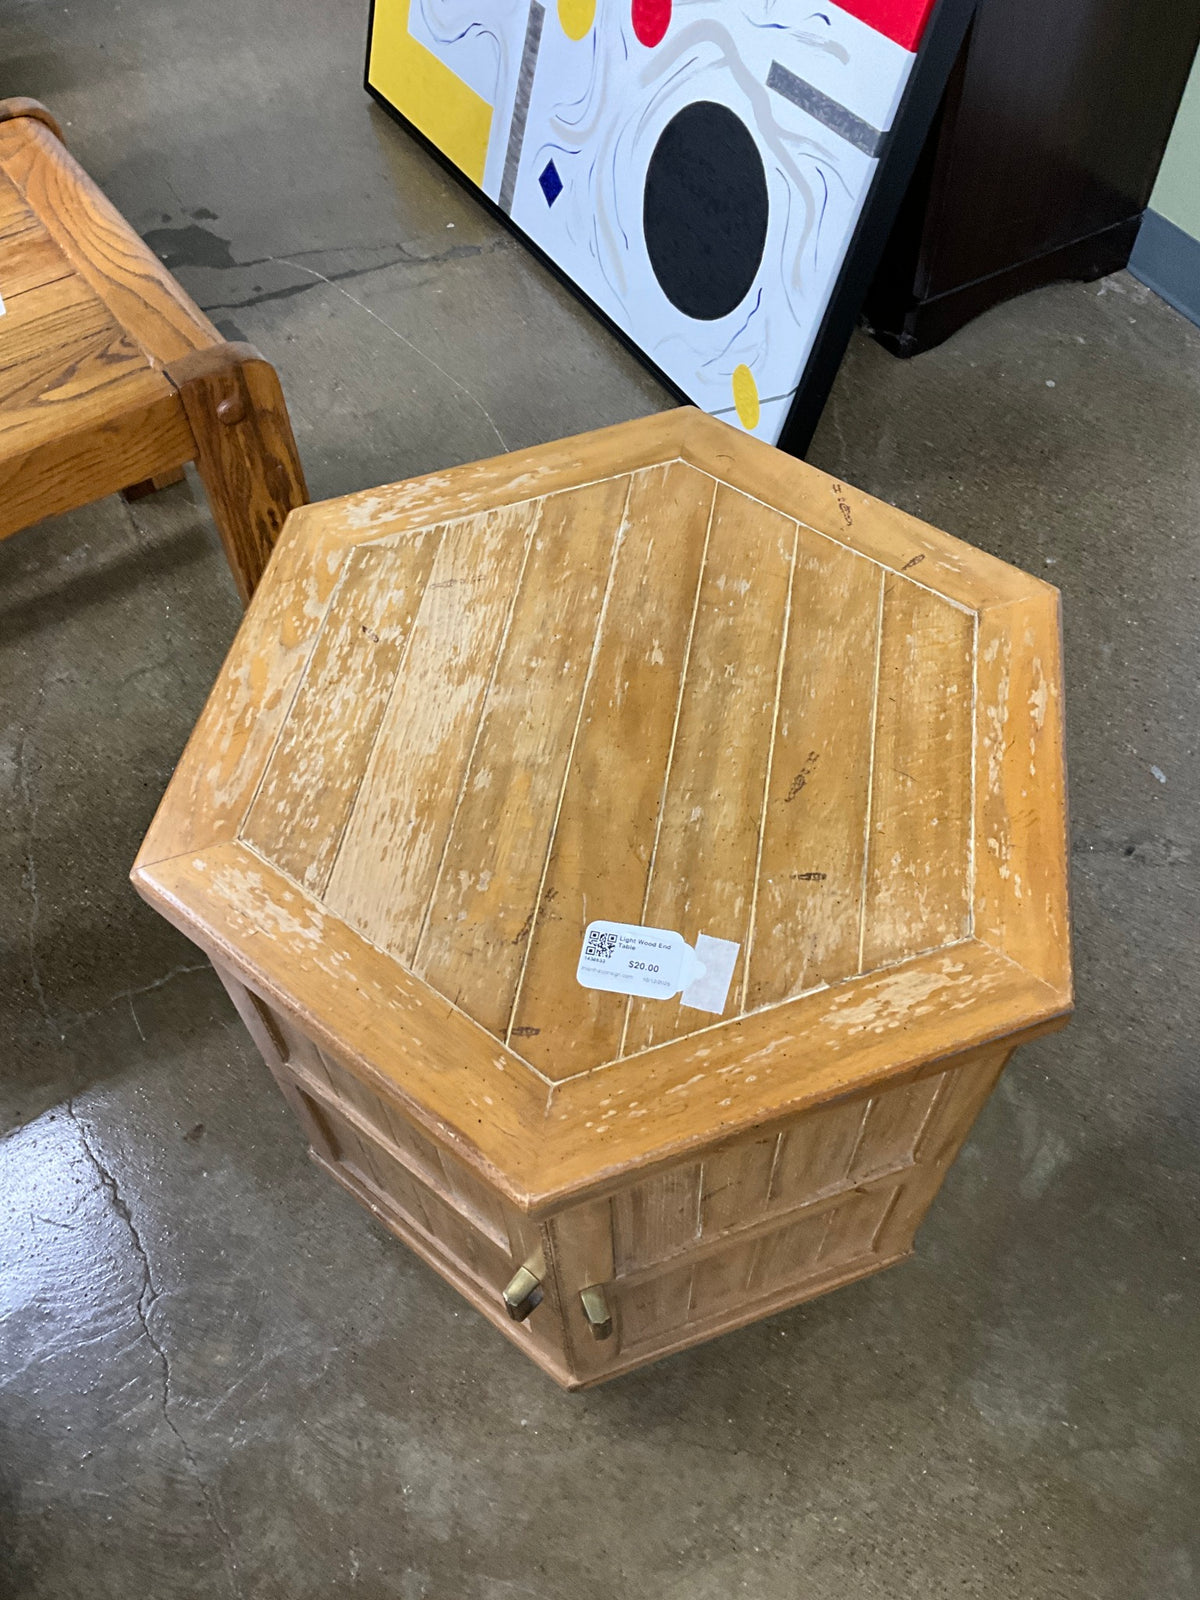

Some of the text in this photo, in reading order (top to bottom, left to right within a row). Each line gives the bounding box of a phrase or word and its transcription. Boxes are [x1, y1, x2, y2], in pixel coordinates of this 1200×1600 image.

[618, 943, 636, 951] Table
[619, 935, 671, 950] Light Wood End
[628, 960, 659, 973] $20.00
